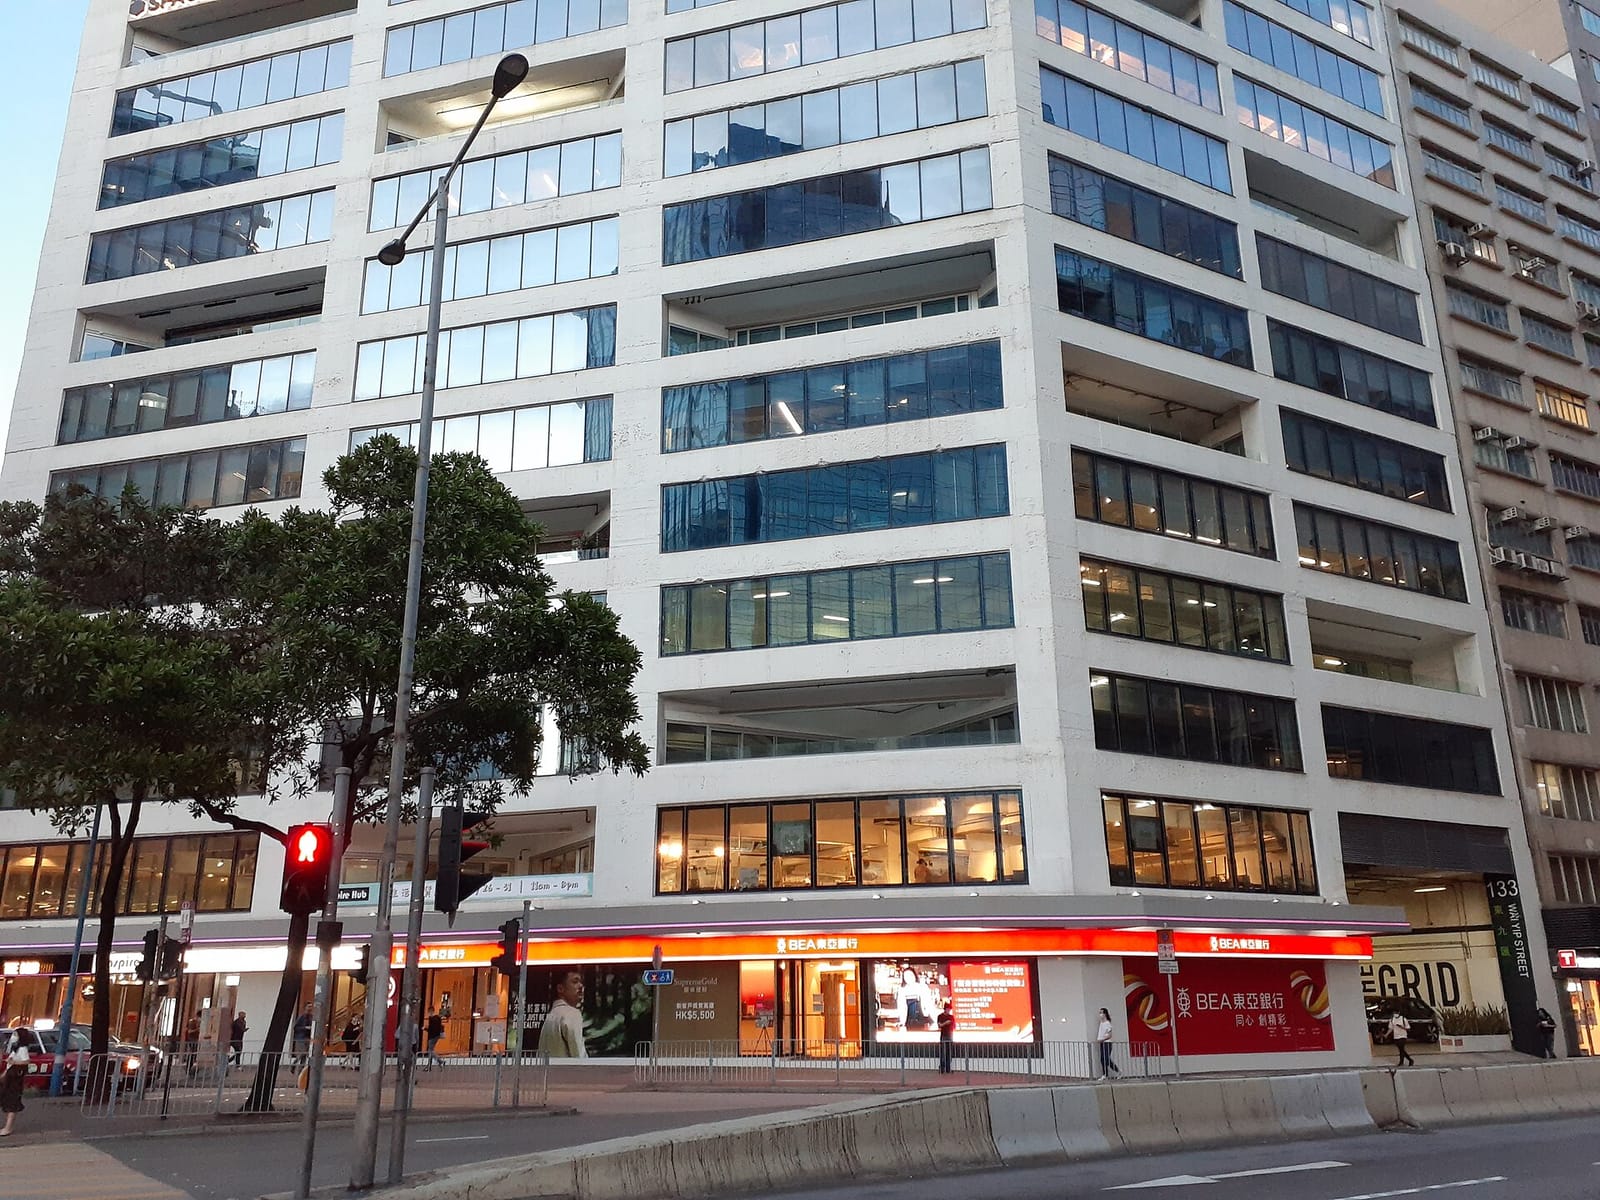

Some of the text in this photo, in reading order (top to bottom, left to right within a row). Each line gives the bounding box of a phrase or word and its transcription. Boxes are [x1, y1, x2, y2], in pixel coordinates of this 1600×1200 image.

[351, 890, 367, 899] Hub
[1487, 879, 1518, 898] 133
[1508, 903, 1529, 978] WAI YIP STREET
[1561, 953, 1573, 965] T
[1378, 961, 1460, 1007] GRID
[1196, 992, 1284, 1010] BEA 東亞銀行
[675, 1010, 715, 1020] HK$5,500
[1235, 1014, 1254, 1027] 同心
